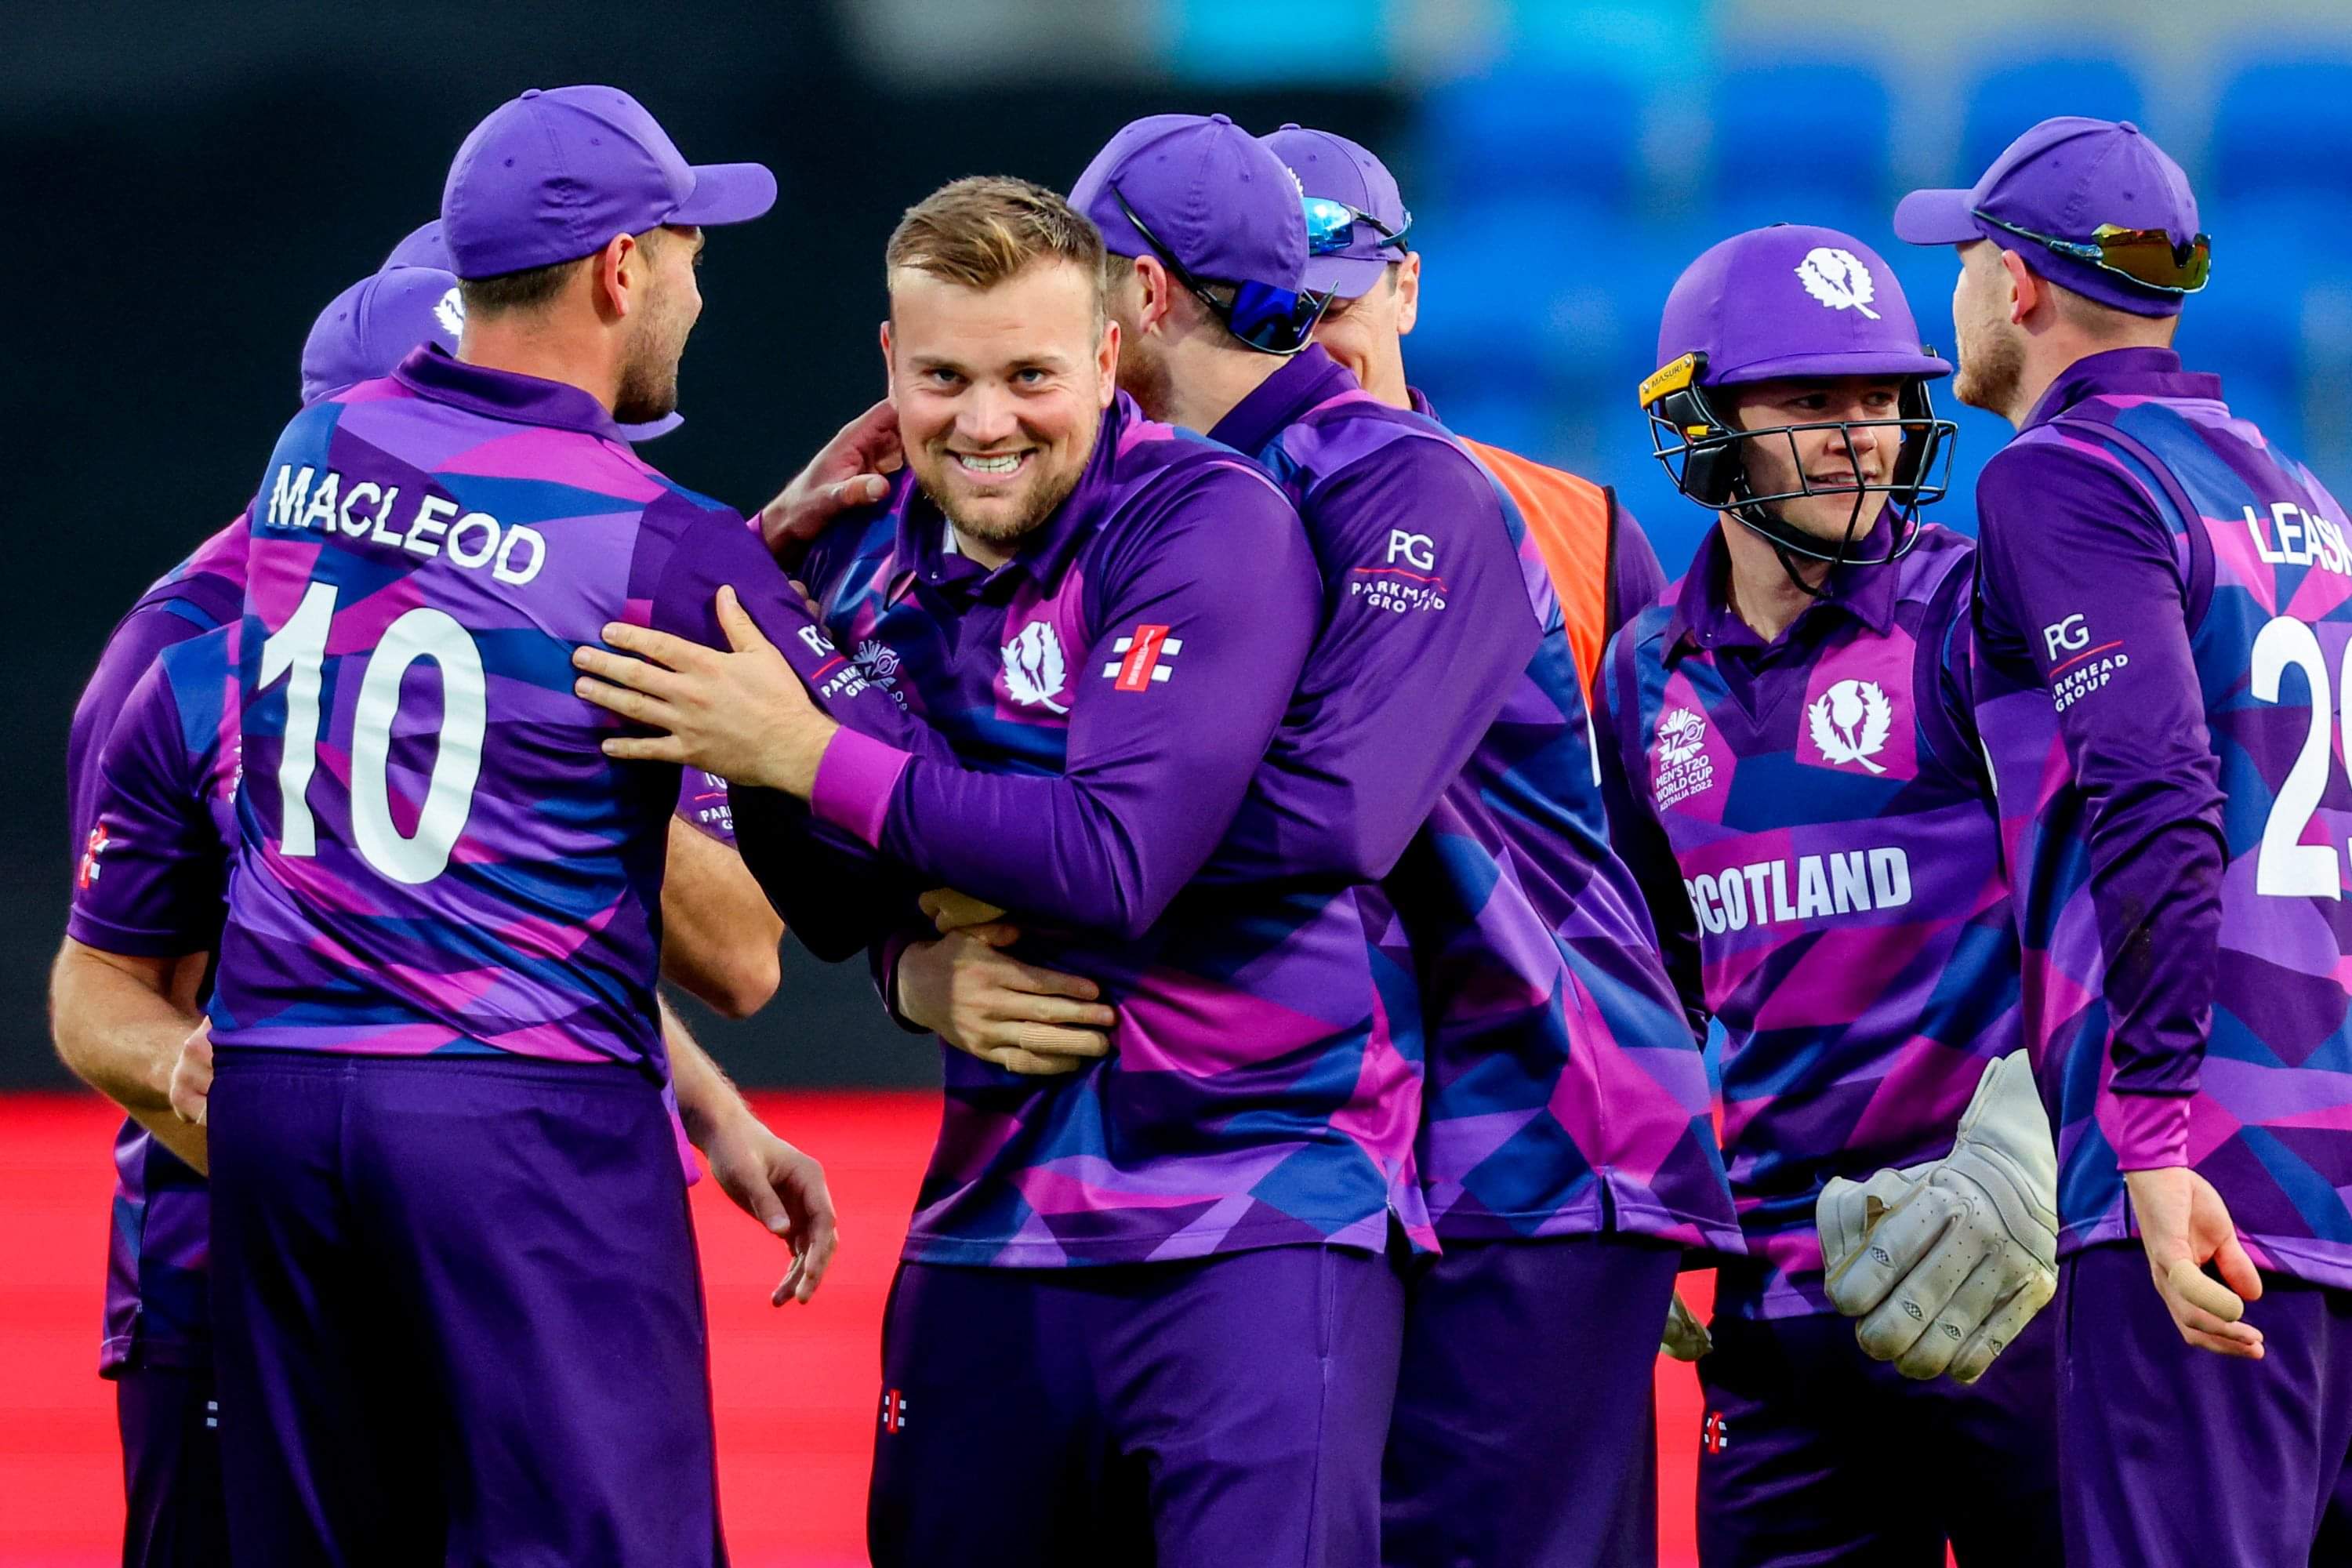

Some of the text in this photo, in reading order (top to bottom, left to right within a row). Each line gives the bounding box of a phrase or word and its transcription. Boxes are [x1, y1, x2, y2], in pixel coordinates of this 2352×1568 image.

[1651, 363, 1683, 389] MASURI
[266, 464, 546, 586] MACLEOD
[1387, 528, 1435, 571] PG
[2043, 613, 2090, 661] PG
[2053, 654, 2129, 700] RKMEAD
[2055, 672, 2111, 713] GROUP
[258, 580, 488, 884] 10
[1656, 754, 1710, 789] MEN'S T20
[2251, 615, 2352, 902] 2
[1656, 765, 1714, 803] WORLD CUP
[1690, 779, 1714, 795] 2022
